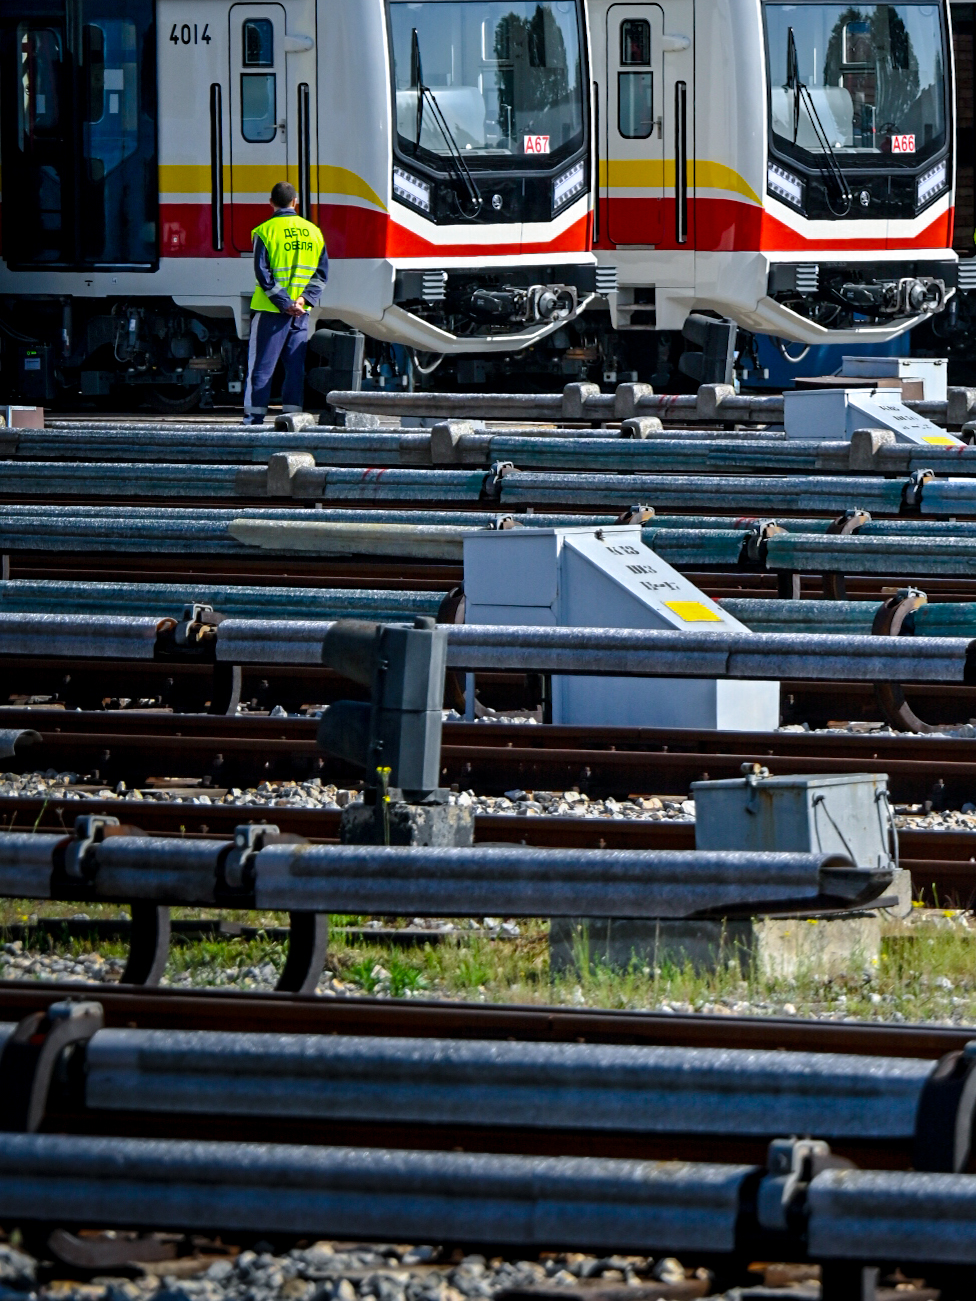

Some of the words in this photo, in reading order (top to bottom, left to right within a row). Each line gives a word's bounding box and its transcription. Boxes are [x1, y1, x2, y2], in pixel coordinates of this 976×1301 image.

[169, 23, 212, 45] 4014
[525, 135, 550, 154] A67
[892, 134, 915, 152] A66
